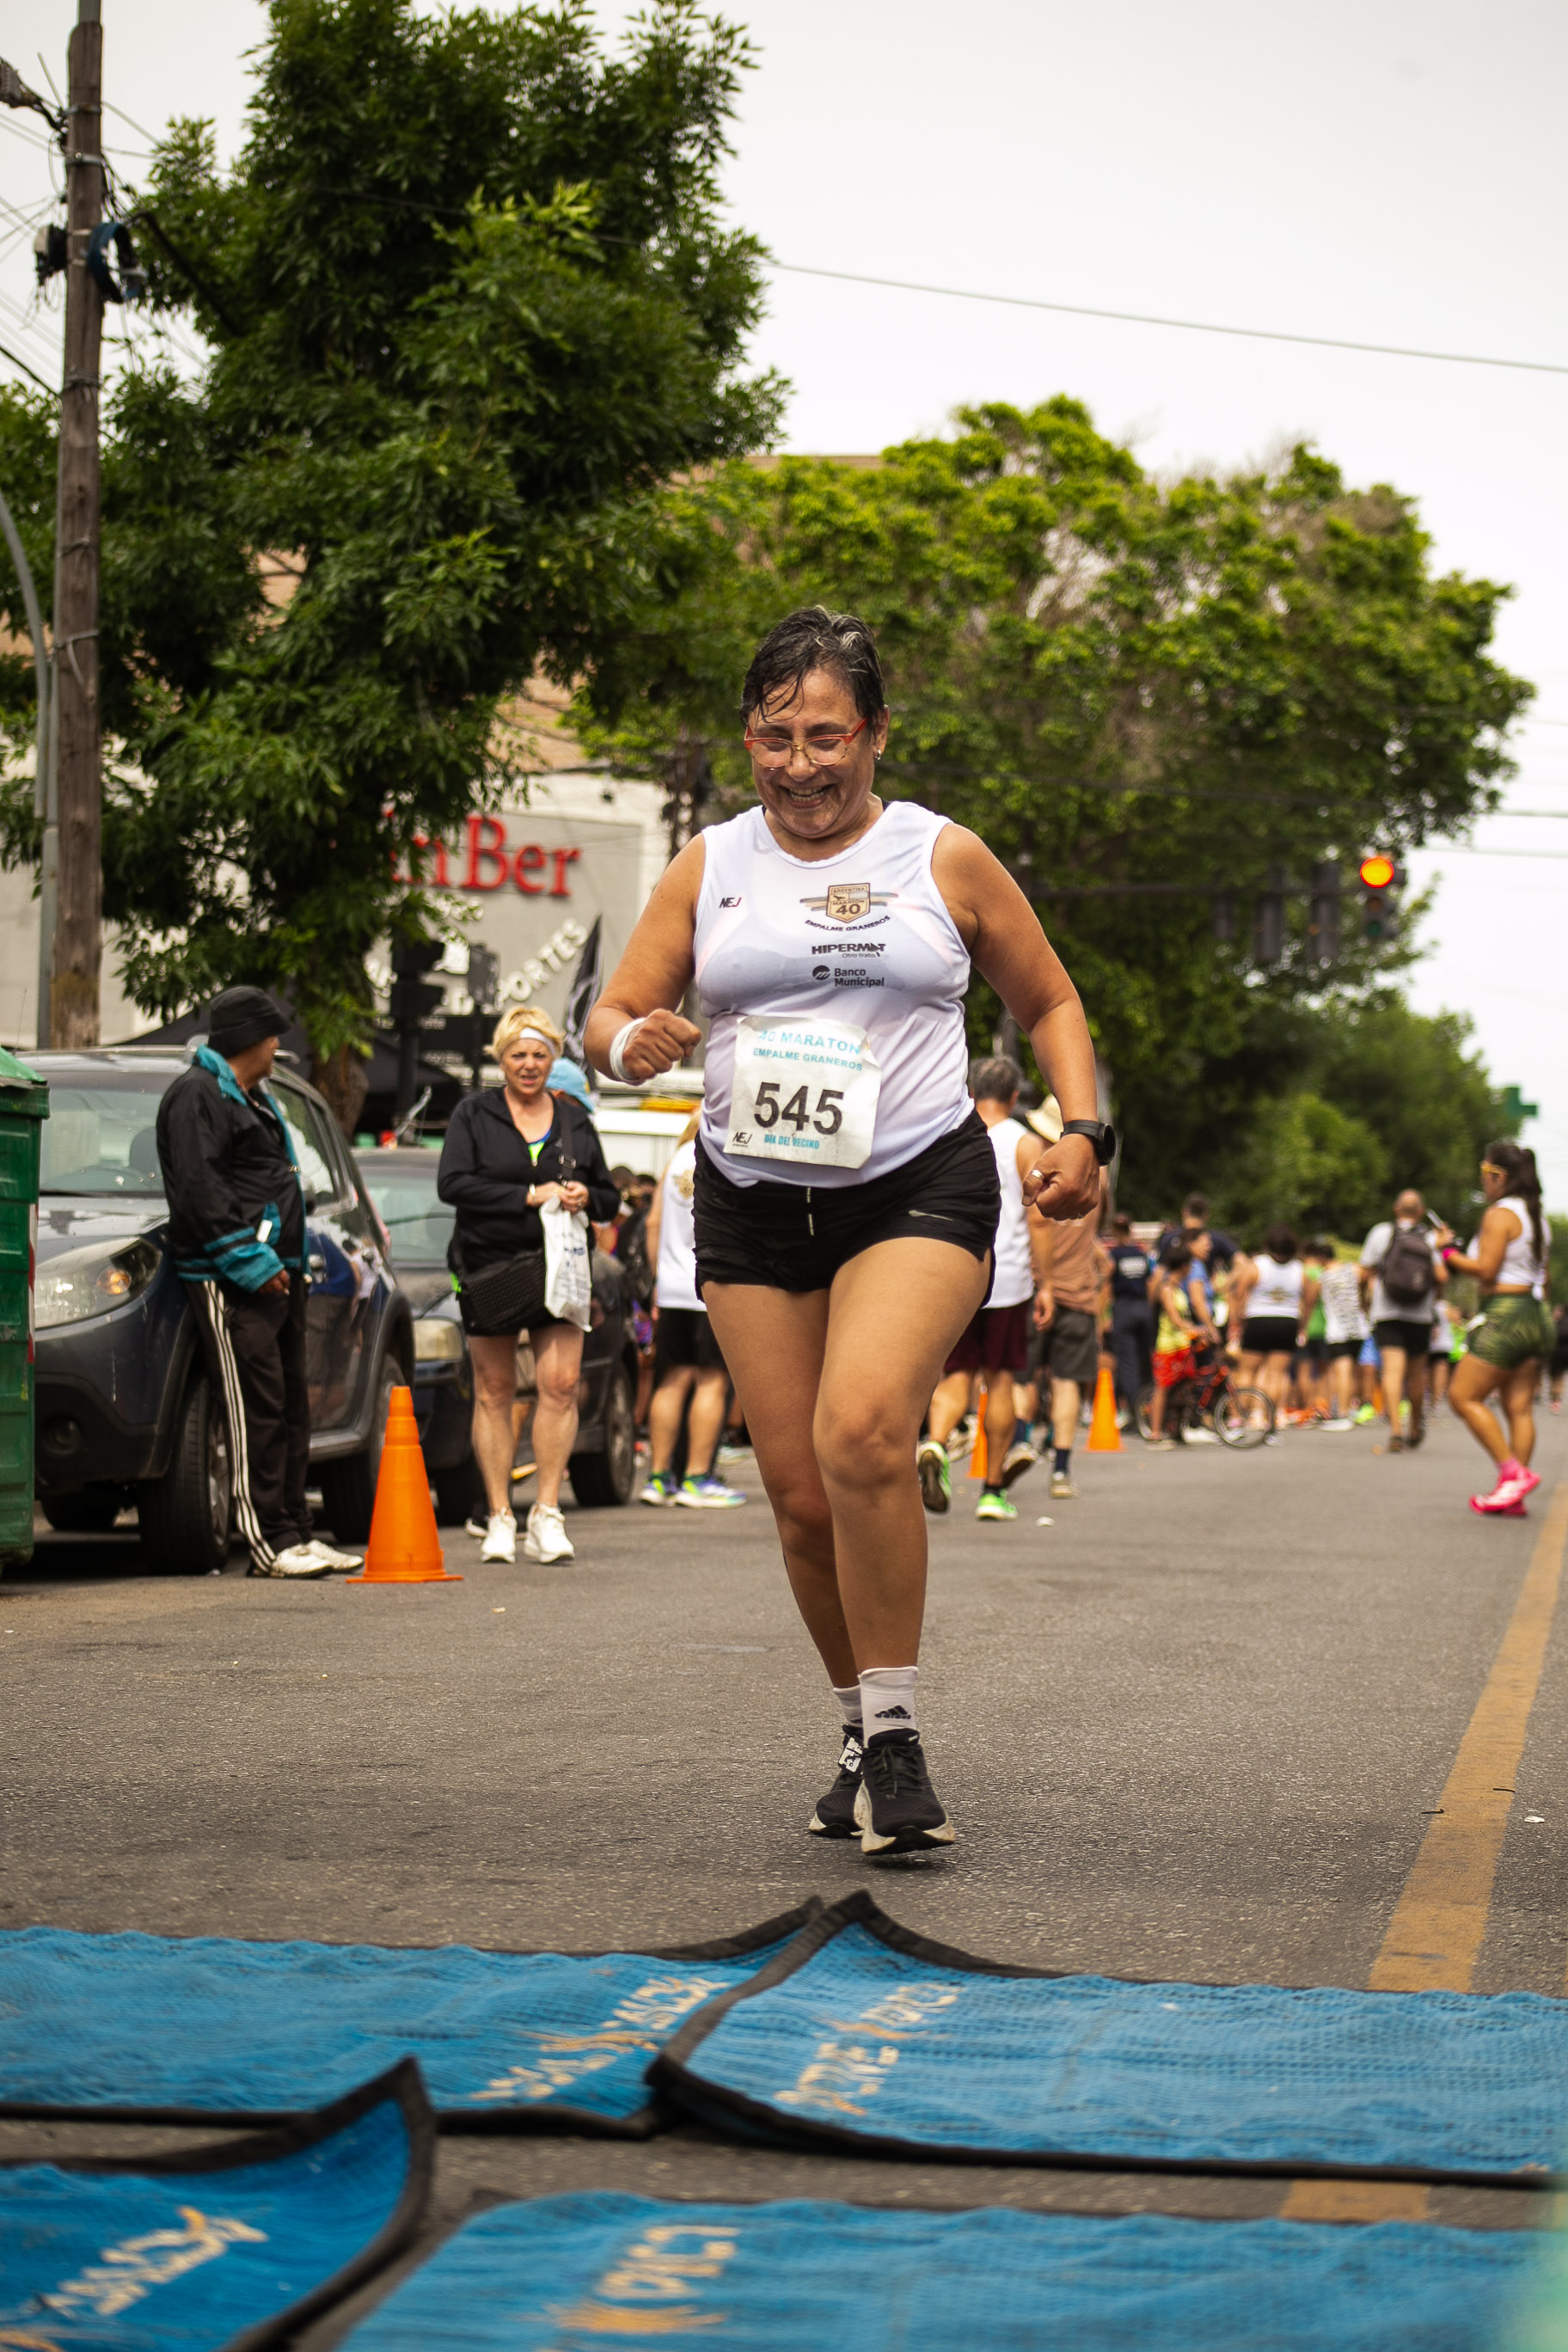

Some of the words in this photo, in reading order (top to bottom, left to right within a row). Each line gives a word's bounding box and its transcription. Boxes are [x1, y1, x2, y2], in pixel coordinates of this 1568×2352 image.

[836, 903, 861, 916] 40
[805, 919, 844, 932] EMPALME
[845, 916, 891, 931] GRANEROS
[834, 968, 867, 977] Banco
[834, 977, 885, 988] Municipal
[758, 1030, 776, 1042] 40
[781, 1032, 861, 1056] MARATON
[753, 1047, 799, 1061] EMPALME
[803, 1053, 863, 1072] GRANEROS
[754, 1081, 845, 1136] 545
[778, 1136, 790, 1146] DEL
[792, 1136, 820, 1150] VECINO
